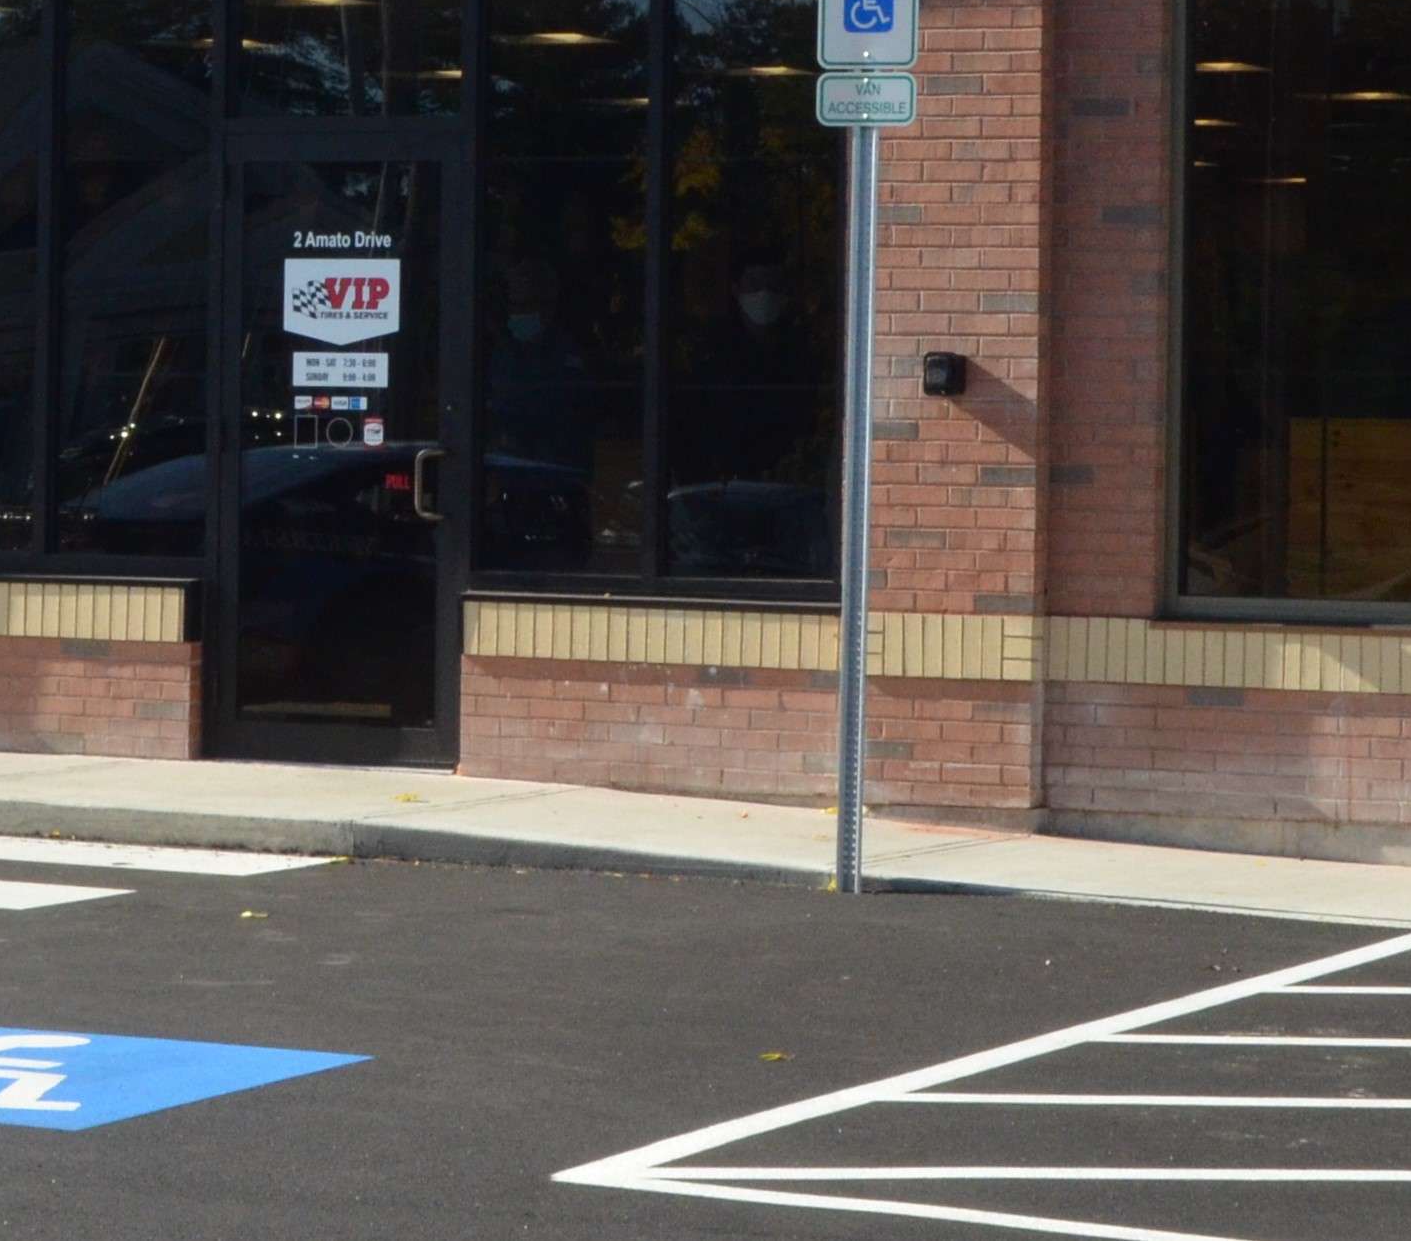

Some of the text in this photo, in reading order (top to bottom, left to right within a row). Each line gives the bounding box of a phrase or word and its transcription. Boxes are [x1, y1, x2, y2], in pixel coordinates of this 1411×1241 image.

[855, 84, 881, 97] VAN
[827, 102, 907, 115] ACCESSIBLE
[293, 230, 392, 248] 2 Amato Drive
[324, 277, 390, 310] VIP
[385, 474, 411, 490] PULL
